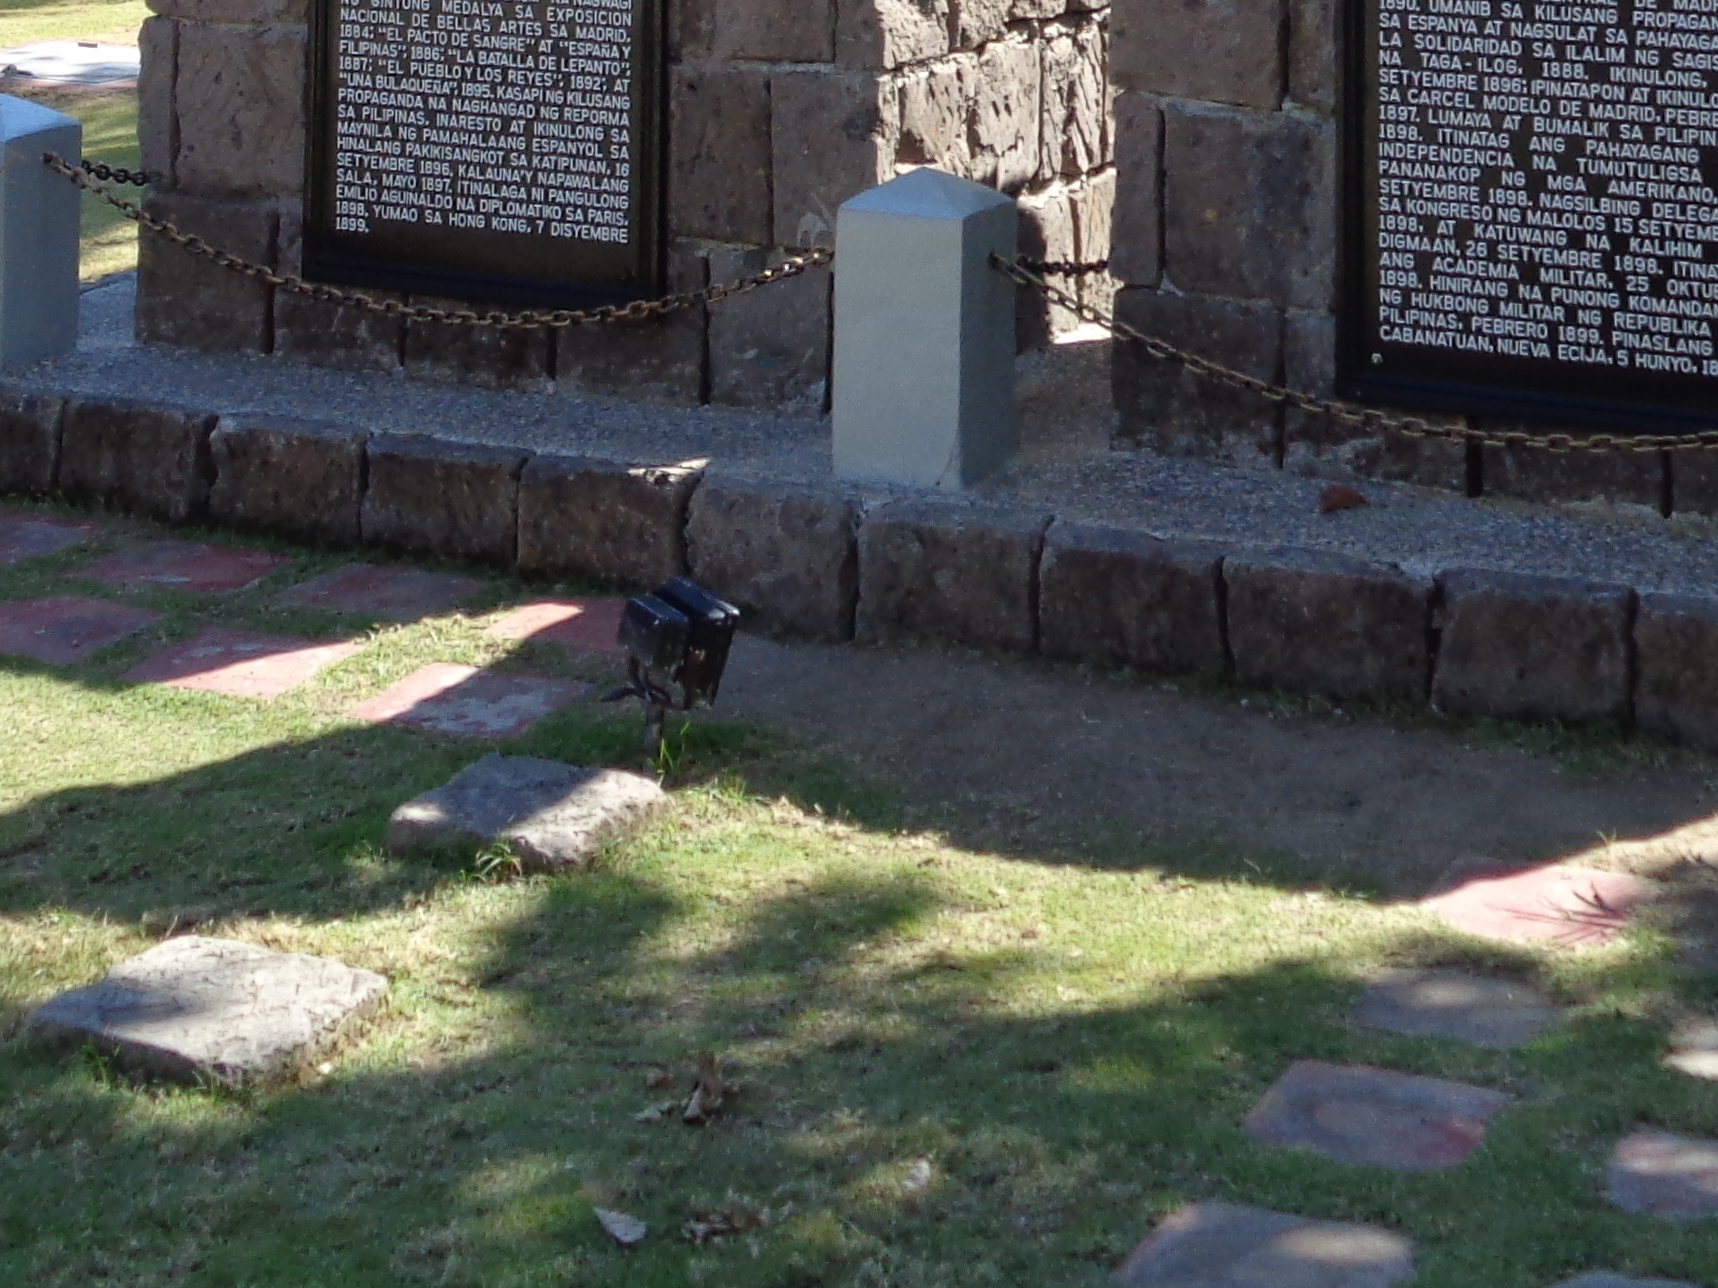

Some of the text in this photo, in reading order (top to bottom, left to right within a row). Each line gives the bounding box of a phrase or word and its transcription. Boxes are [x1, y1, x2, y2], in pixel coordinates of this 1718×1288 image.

[340, 7, 404, 26] NACIONAL
[411, 12, 429, 28] DE
[436, 14, 490, 32] BELLAS
[498, 18, 542, 36] ARTES
[549, 22, 568, 38] SA
[514, 3, 533, 19] SA
[546, 5, 631, 26] EXPOSICION
[1378, 12, 1401, 29] SA
[1407, 14, 1477, 34] ESPANYA
[1483, 19, 1501, 36] AT
[1510, 20, 1597, 42] NAGSULAT
[1604, 26, 1628, 44] SA
[1500, 1, 1523, 19] SA
[1534, 3, 1618, 24] KILUSANG
[337, 88, 629, 126] PROPAGANDA NA NAGHANGAD NG REPORMA
[1378, 86, 1401, 104] SA
[1406, 88, 1475, 109] CARCEL
[1482, 93, 1550, 115] MODELO
[1559, 99, 1582, 117] DE
[1588, 101, 1661, 123] MADRID,
[1379, 104, 1420, 123] 1897.
[1427, 108, 1491, 128] LUMAYA
[1502, 113, 1521, 131] AT
[1533, 116, 1608, 137] BUMALIK
[1619, 122, 1643, 140] SA
[337, 120, 629, 159] MAYNILA NG PAMAHALAANG ESPANYOL SA
[1378, 123, 1423, 142] 1898.
[1437, 127, 1509, 148] ITINATAG
[1528, 134, 1565, 153] ANG
[1585, 139, 1699, 163] PAHAYAGANG
[336, 151, 414, 173] SETYEMBRE
[419, 159, 453, 176] 1896.
[537, 170, 629, 192] NAPAWALANG
[1378, 141, 1514, 168] INDEPENDENCIA
[1532, 153, 1556, 171] NA
[1577, 157, 1702, 183] TUMUTULIGSA
[336, 168, 628, 209] SALA, MAYO 1897. ITINALAGA NI PANGULONG
[1378, 160, 1480, 183] PANANAKOP
[1501, 169, 1525, 187] NG
[1547, 173, 1586, 192] MGA
[1606, 178, 1718, 203] AMERIKANO,
[335, 184, 377, 202] EMILIO
[380, 188, 453, 209] AGUINALDO
[456, 195, 475, 211] NA
[479, 198, 561, 220] DIPLOMATIKO
[565, 206, 584, 222] SA
[335, 215, 369, 232] 1899.
[372, 204, 417, 222] YUMAO
[424, 209, 442, 224] SA
[448, 211, 485, 228] HONG
[537, 219, 544, 234] 7
[550, 220, 628, 242] DISYEMBRE
[1378, 232, 1460, 255] DIGMAAN,
[1465, 239, 1487, 258] 26
[1496, 242, 1601, 269] SETYEMBRE
[1614, 253, 1663, 275] 1898.
[1379, 251, 1414, 271] ANG
[1431, 256, 1519, 280] ACADEMIA
[1539, 266, 1613, 289] MILITAR,
[1625, 274, 1649, 293] 25
[1379, 269, 1422, 289] 1898.
[1429, 274, 1508, 297] HINIRANG
[1518, 283, 1542, 301] NA
[1550, 286, 1619, 308] PUNONG
[1379, 306, 1463, 330] PILIPINAS,
[1471, 315, 1548, 339] PEBRERO
[1558, 324, 1604, 345] 1899.
[1611, 330, 1713, 356] PINASLANG
